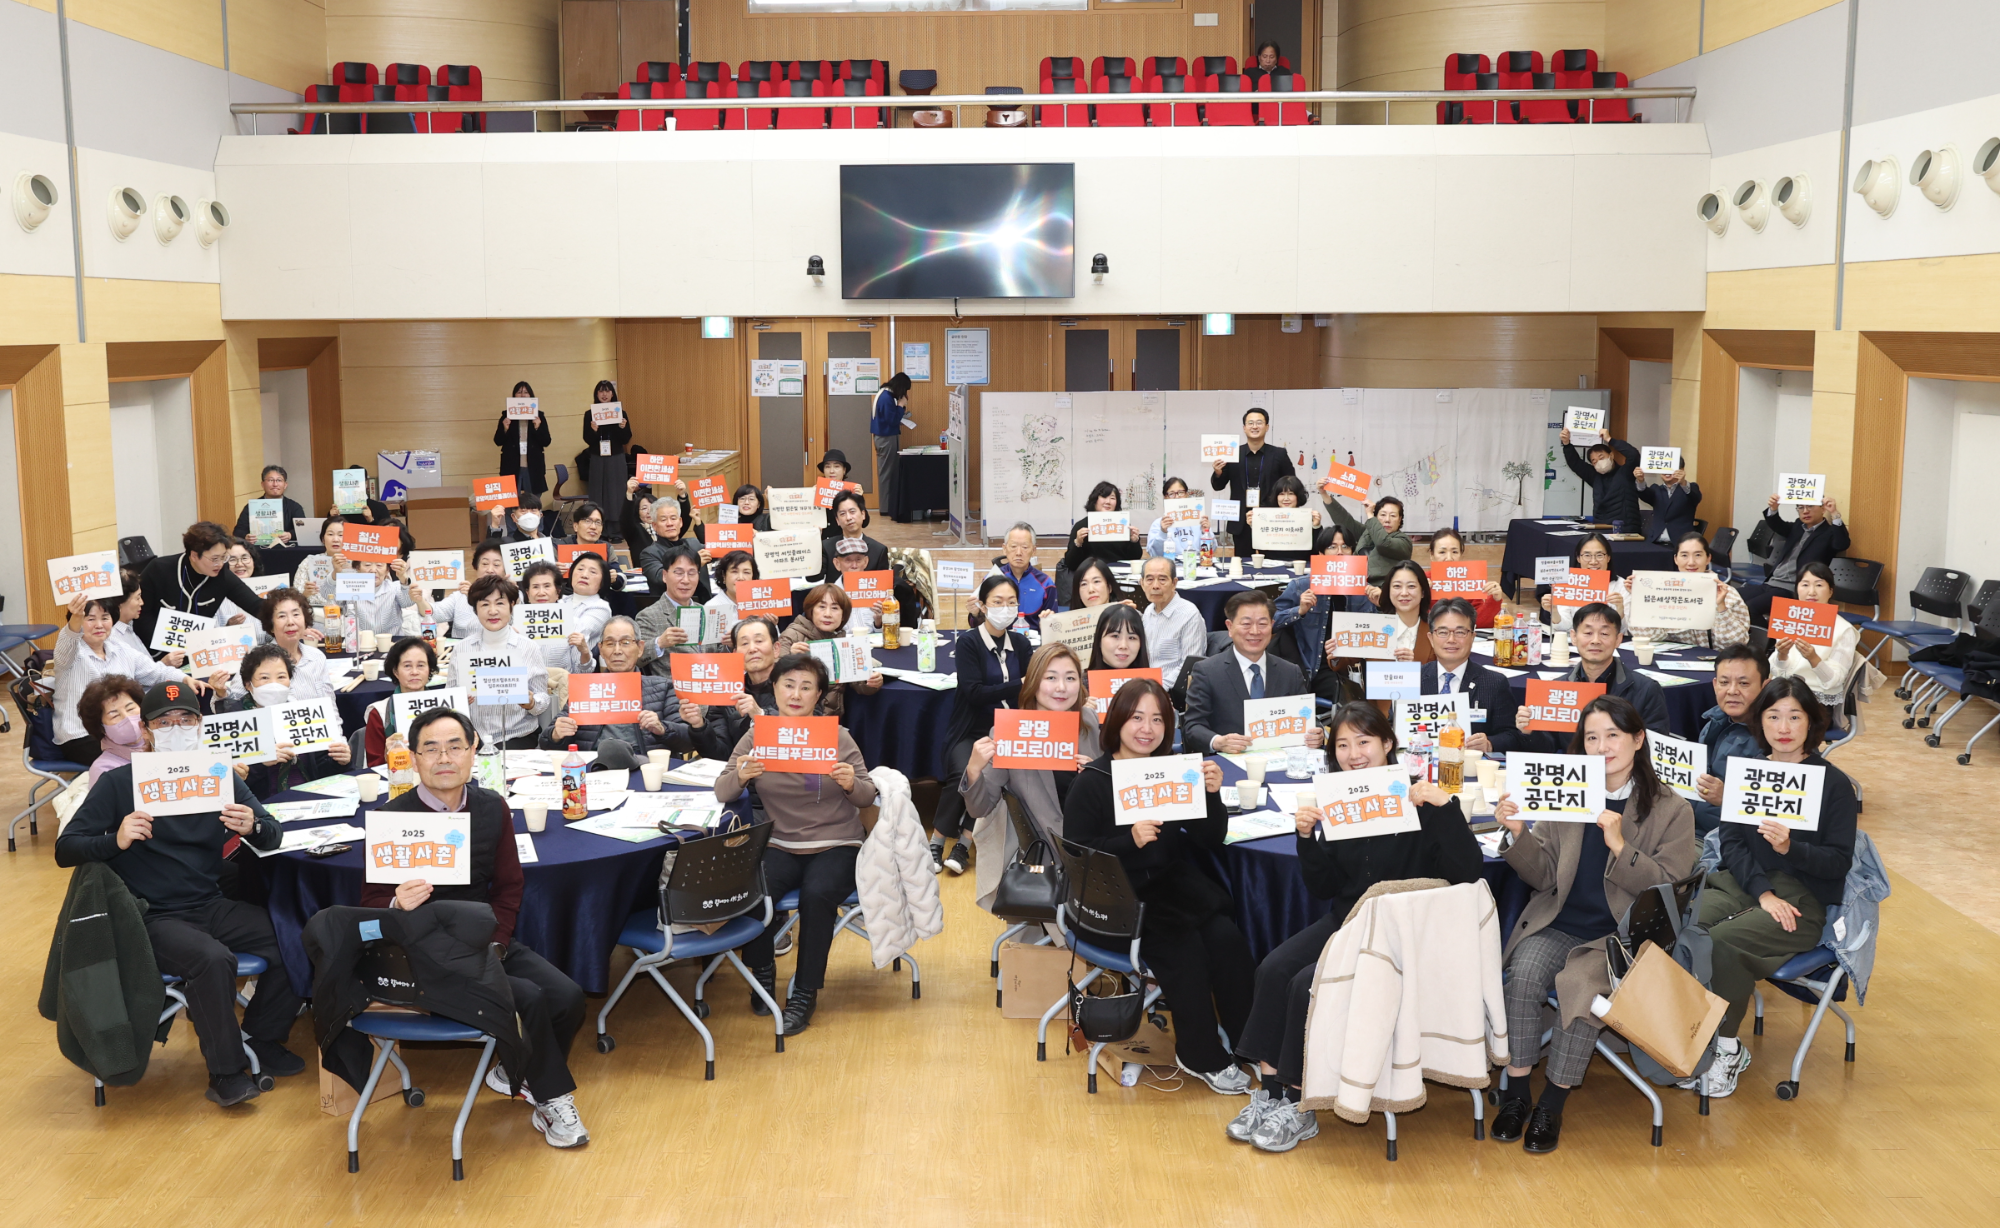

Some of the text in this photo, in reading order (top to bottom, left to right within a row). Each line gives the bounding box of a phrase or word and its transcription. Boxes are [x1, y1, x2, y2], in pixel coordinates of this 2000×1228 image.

[1574, 410, 1598, 420] 광명시
[1573, 420, 1596, 430] 공단지
[1204, 446, 1233, 456] 생활사촌
[1648, 450, 1674, 460] 광명시
[649, 456, 664, 464] 하안
[1647, 460, 1672, 470] 공단지
[642, 474, 671, 482] 센트레빌
[698, 478, 712, 488] 하안
[1340, 471, 1357, 483] 소하
[1787, 477, 1816, 489] 광명시
[485, 482, 502, 494] 일직
[829, 480, 844, 489] 하안
[698, 496, 724, 507] 센트레빌
[1786, 489, 1814, 500] 공단지
[1167, 510, 1200, 521] 생활사촌
[718, 530, 737, 541] 일직
[1092, 524, 1123, 535] 생활사촌
[358, 531, 380, 544] 철산
[342, 542, 398, 556] 푸르지오하늘채
[510, 544, 544, 562] 광명시
[72, 564, 88, 572] 2025
[1326, 561, 1348, 572] 하안
[1446, 567, 1467, 578] 하안
[416, 567, 456, 581] 생활사촌
[1311, 575, 1366, 587] 주공13단지
[1568, 573, 1590, 586] 하안
[56, 572, 109, 593] 생활사촌
[858, 578, 878, 590] 철산
[1432, 580, 1486, 592] 주공13단지
[752, 586, 772, 600] 철산
[1553, 586, 1606, 602] 주공5단지
[1644, 595, 1704, 605] 넓은세상작은도서관
[738, 598, 792, 612] 푸르지오하늘채
[525, 608, 563, 624] 광명시
[1788, 604, 1815, 622] 하안
[526, 625, 563, 640] 공단지
[1771, 618, 1832, 640] 주공5단지
[210, 638, 226, 646] 2025
[1338, 633, 1388, 647] 생활사촌
[194, 648, 246, 666] 생활사촌
[691, 663, 720, 680] 철산
[166, 685, 180, 701] SF
[589, 683, 616, 698] 철산
[673, 680, 744, 694] 센트럴푸르지오
[1548, 689, 1578, 706] 광명
[569, 700, 642, 714] 센트럴푸르지오
[1407, 700, 1456, 720] 광명시
[282, 706, 325, 727] 광명시
[204, 716, 258, 741] 광명시
[1018, 720, 1050, 738] 광명
[1251, 718, 1304, 737] 생활사촌
[290, 724, 329, 746] 공단지
[778, 727, 810, 745] 철산
[754, 746, 837, 762] 센트럴푸르지오
[997, 740, 1074, 760] 해모로이연
[1654, 740, 1693, 766] 광명시
[168, 766, 190, 774] 2025
[1144, 772, 1165, 780] 2025
[1524, 762, 1586, 786] 광명시
[1654, 762, 1692, 787] 공단지
[1744, 767, 1806, 793] 광명시
[142, 776, 217, 801] 생활사촌
[1123, 784, 1190, 807] 생활사촌
[1348, 785, 1370, 794] 2025
[1524, 788, 1586, 811] 공단지
[1742, 792, 1802, 817] 공단지
[1329, 797, 1399, 822] 생활사촌
[402, 829, 425, 838] 2025
[376, 844, 452, 867] 생활사촌
